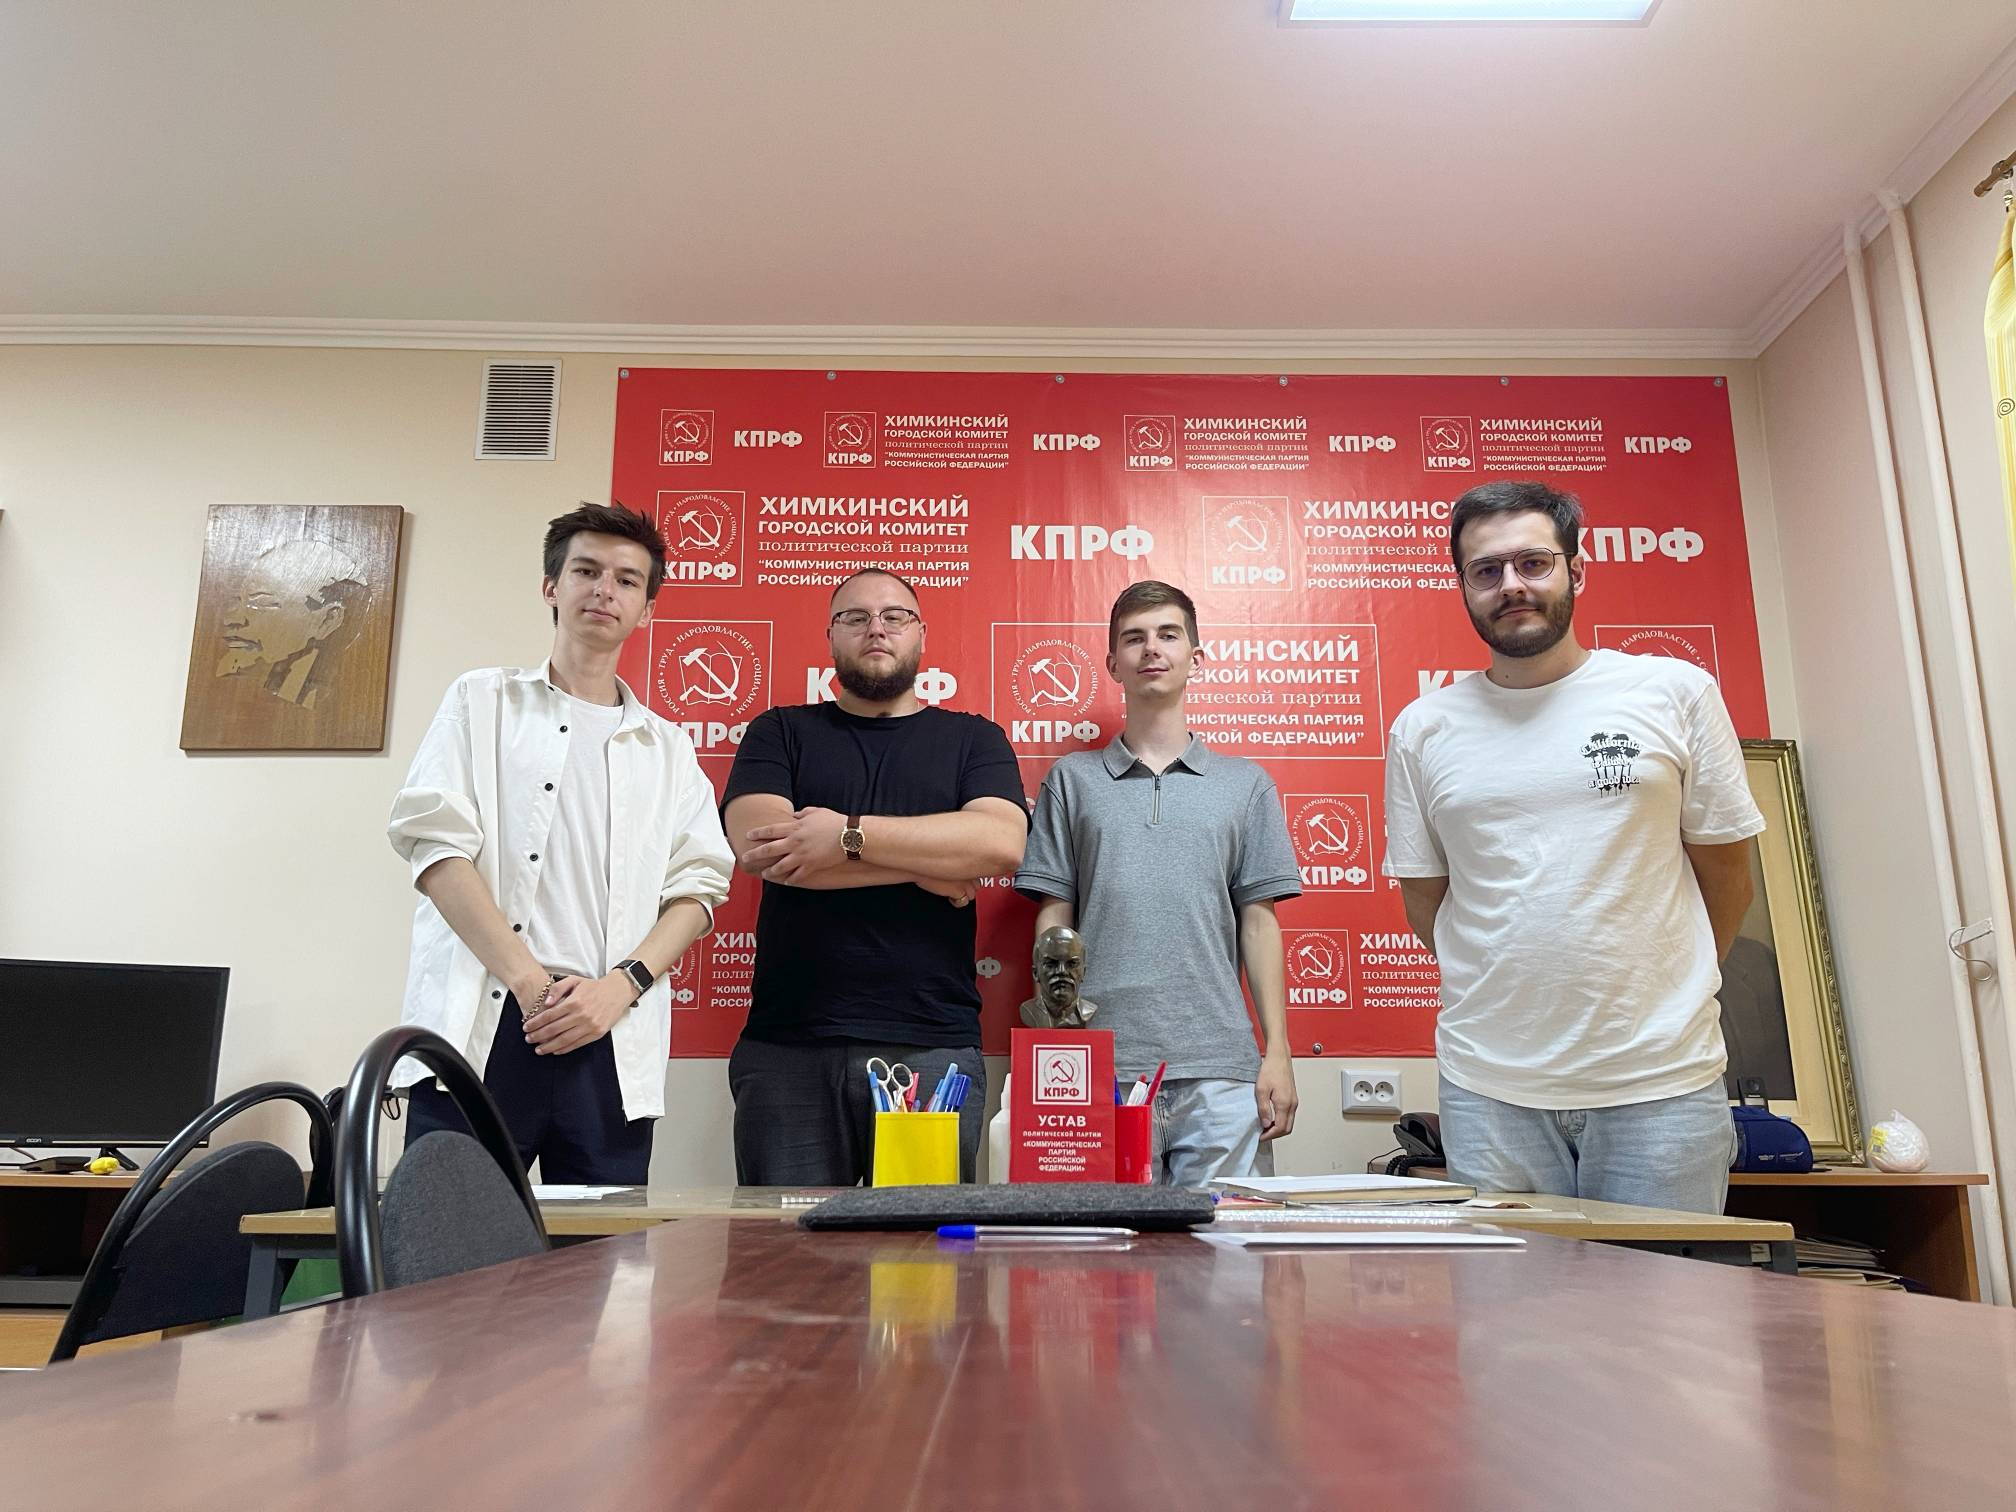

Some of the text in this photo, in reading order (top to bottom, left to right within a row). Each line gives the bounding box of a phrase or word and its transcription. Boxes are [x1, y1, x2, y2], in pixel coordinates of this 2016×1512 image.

[885, 414, 1009, 428] ХИМКИНСКИЙ
[1184, 416, 1307, 430] ХИМКИНСКИЙ
[1480, 417, 1602, 431] ХИМКИНСКИЙ
[734, 430, 803, 448] КПРФ
[885, 428, 1008, 439] ГОРОДСКОЙ КОМИТЕТ
[1184, 431, 1307, 441] ГОРОДСКОЙ КОМИТЕТ
[1480, 432, 1603, 442] ГОРОДСКОЙ КОМИТЕТ
[885, 439, 1008, 450] политической партии
[1033, 433, 1101, 450] КПРФ
[1184, 442, 1308, 452] политической партии
[1329, 435, 1397, 452] КПРФ
[1482, 443, 1605, 453] политической партии
[1624, 436, 1692, 453] КПРФ
[663, 450, 709, 463] КПРФ
[828, 452, 873, 465] КПРФ
[1129, 455, 1173, 467] КПРФ
[1428, 456, 1471, 468] КПРФ
[885, 459, 947, 468] РОССИЙСКОЙ
[1185, 462, 1247, 470] РОССИЙСКОЙ
[1483, 463, 1546, 471] РОССИЙСКОЙ
[759, 494, 969, 517] ХИМКИНСКИЙ
[1303, 501, 1456, 520] ХИМКИНС
[758, 520, 969, 536] ГОРОДСКОЙ КОМИТЕТ
[1304, 523, 1417, 539] ГОРОДСКОЙ
[758, 541, 969, 556] политической партии
[1011, 525, 1154, 560] КПРФ
[1306, 543, 1438, 556] политической
[664, 561, 737, 580] КПРФ
[917, 561, 969, 571] ПАРТИЯ
[758, 573, 850, 586] РОССИЙСК
[1212, 566, 1286, 584] КПРФ
[1308, 576, 1412, 589] РОССИЙСКОЙ
[1201, 635, 1360, 662] КИНСКИЙ
[1621, 630, 1698, 656] НАРОДОВЛАСТИЕ
[657, 625, 762, 714] РОССИЯ ТРУД НАРОДОВЛАСТИЕ СОЦИАЛИЗМ
[1256, 668, 1360, 684] КОМИТЕТ
[807, 667, 958, 705] КФ
[1281, 693, 1362, 708] партии
[1303, 714, 1364, 725] ПАРТИЯ
[1012, 720, 1101, 742] КПРФ
[1360, 954, 1437, 967] ГОРОДСКО
[1362, 970, 1439, 979] политичес
[1289, 987, 1347, 1003] КПРФ
[1044, 1087, 1080, 1097] КПРФ
[1038, 1115, 1086, 1127] УСТАВ
[1023, 1130, 1073, 1138] ПОЛИТИЧЕСКОЙ
[1048, 1148, 1076, 1156] ПАРТИЯ
[1038, 1156, 1086, 1164] РОССИЙСКОЙ
